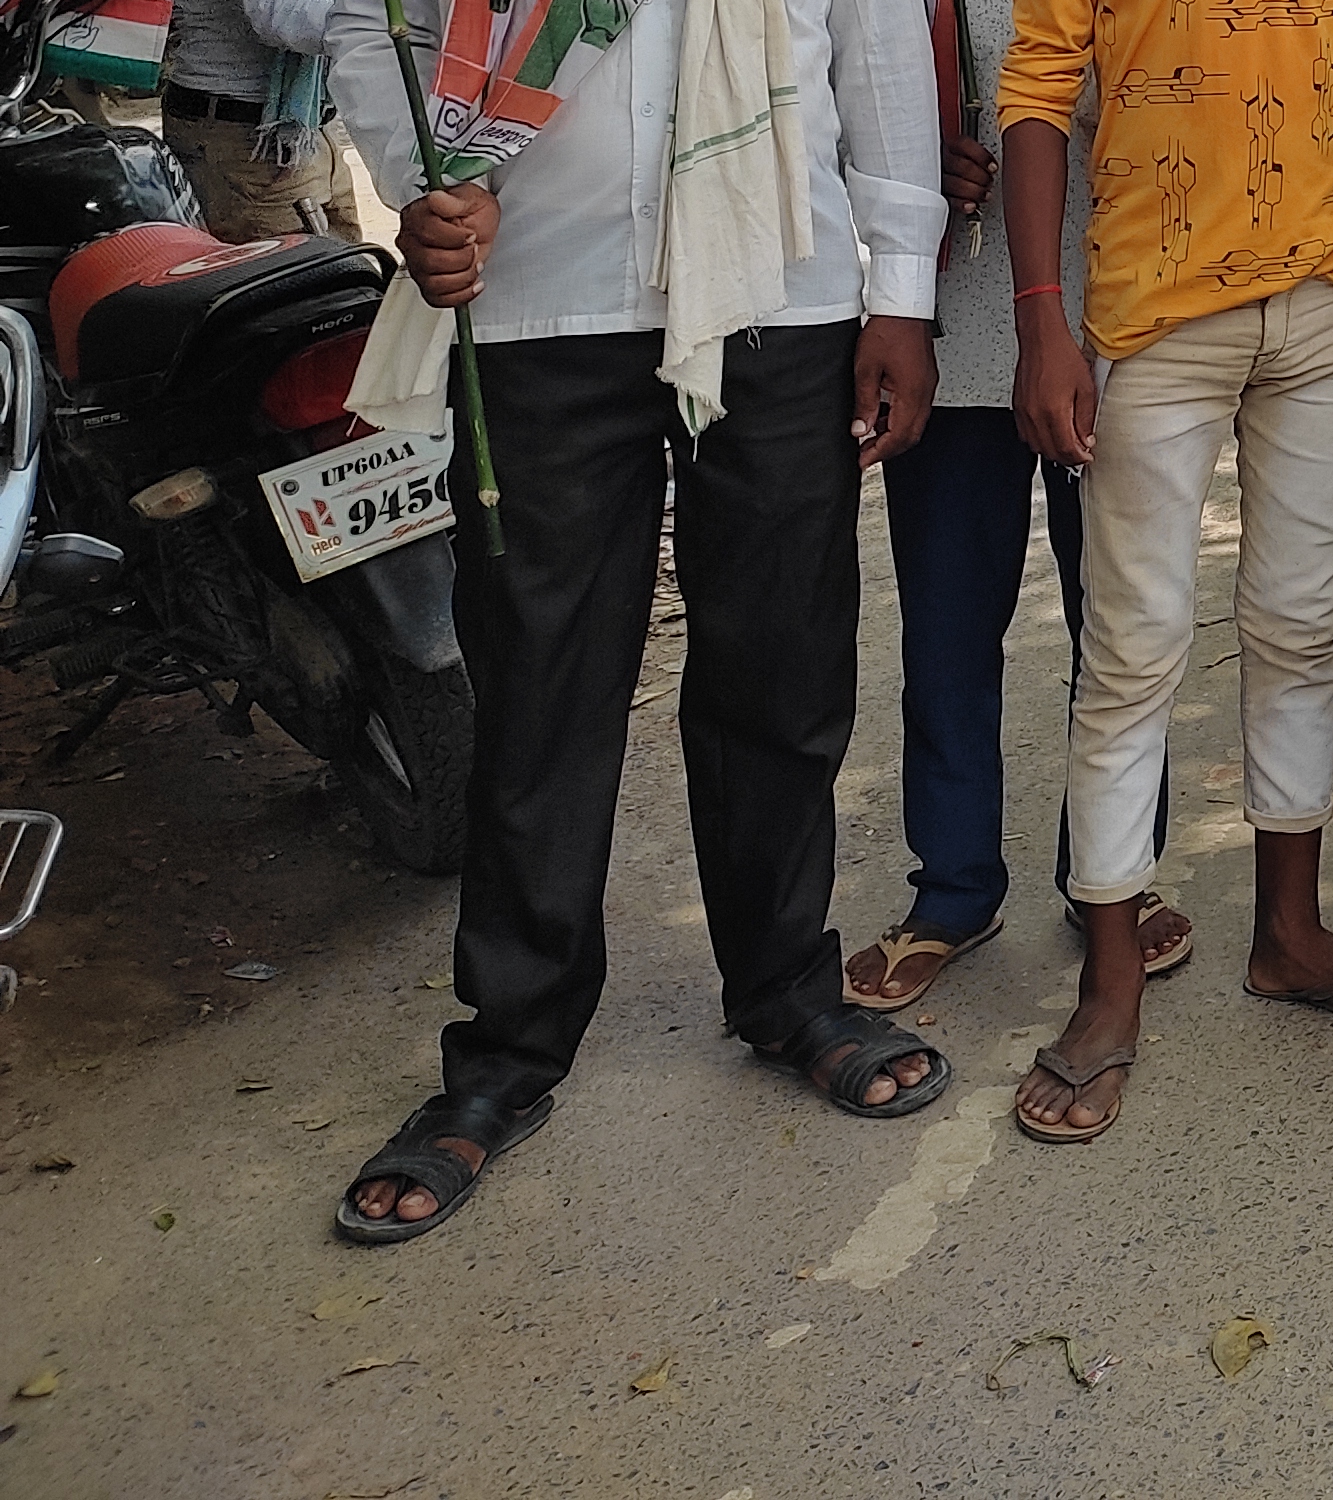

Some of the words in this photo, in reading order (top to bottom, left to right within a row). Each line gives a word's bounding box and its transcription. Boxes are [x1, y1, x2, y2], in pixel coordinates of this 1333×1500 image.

[311, 313, 354, 334] Hero
[321, 441, 416, 487] UP60AA
[311, 534, 342, 556] Hero
